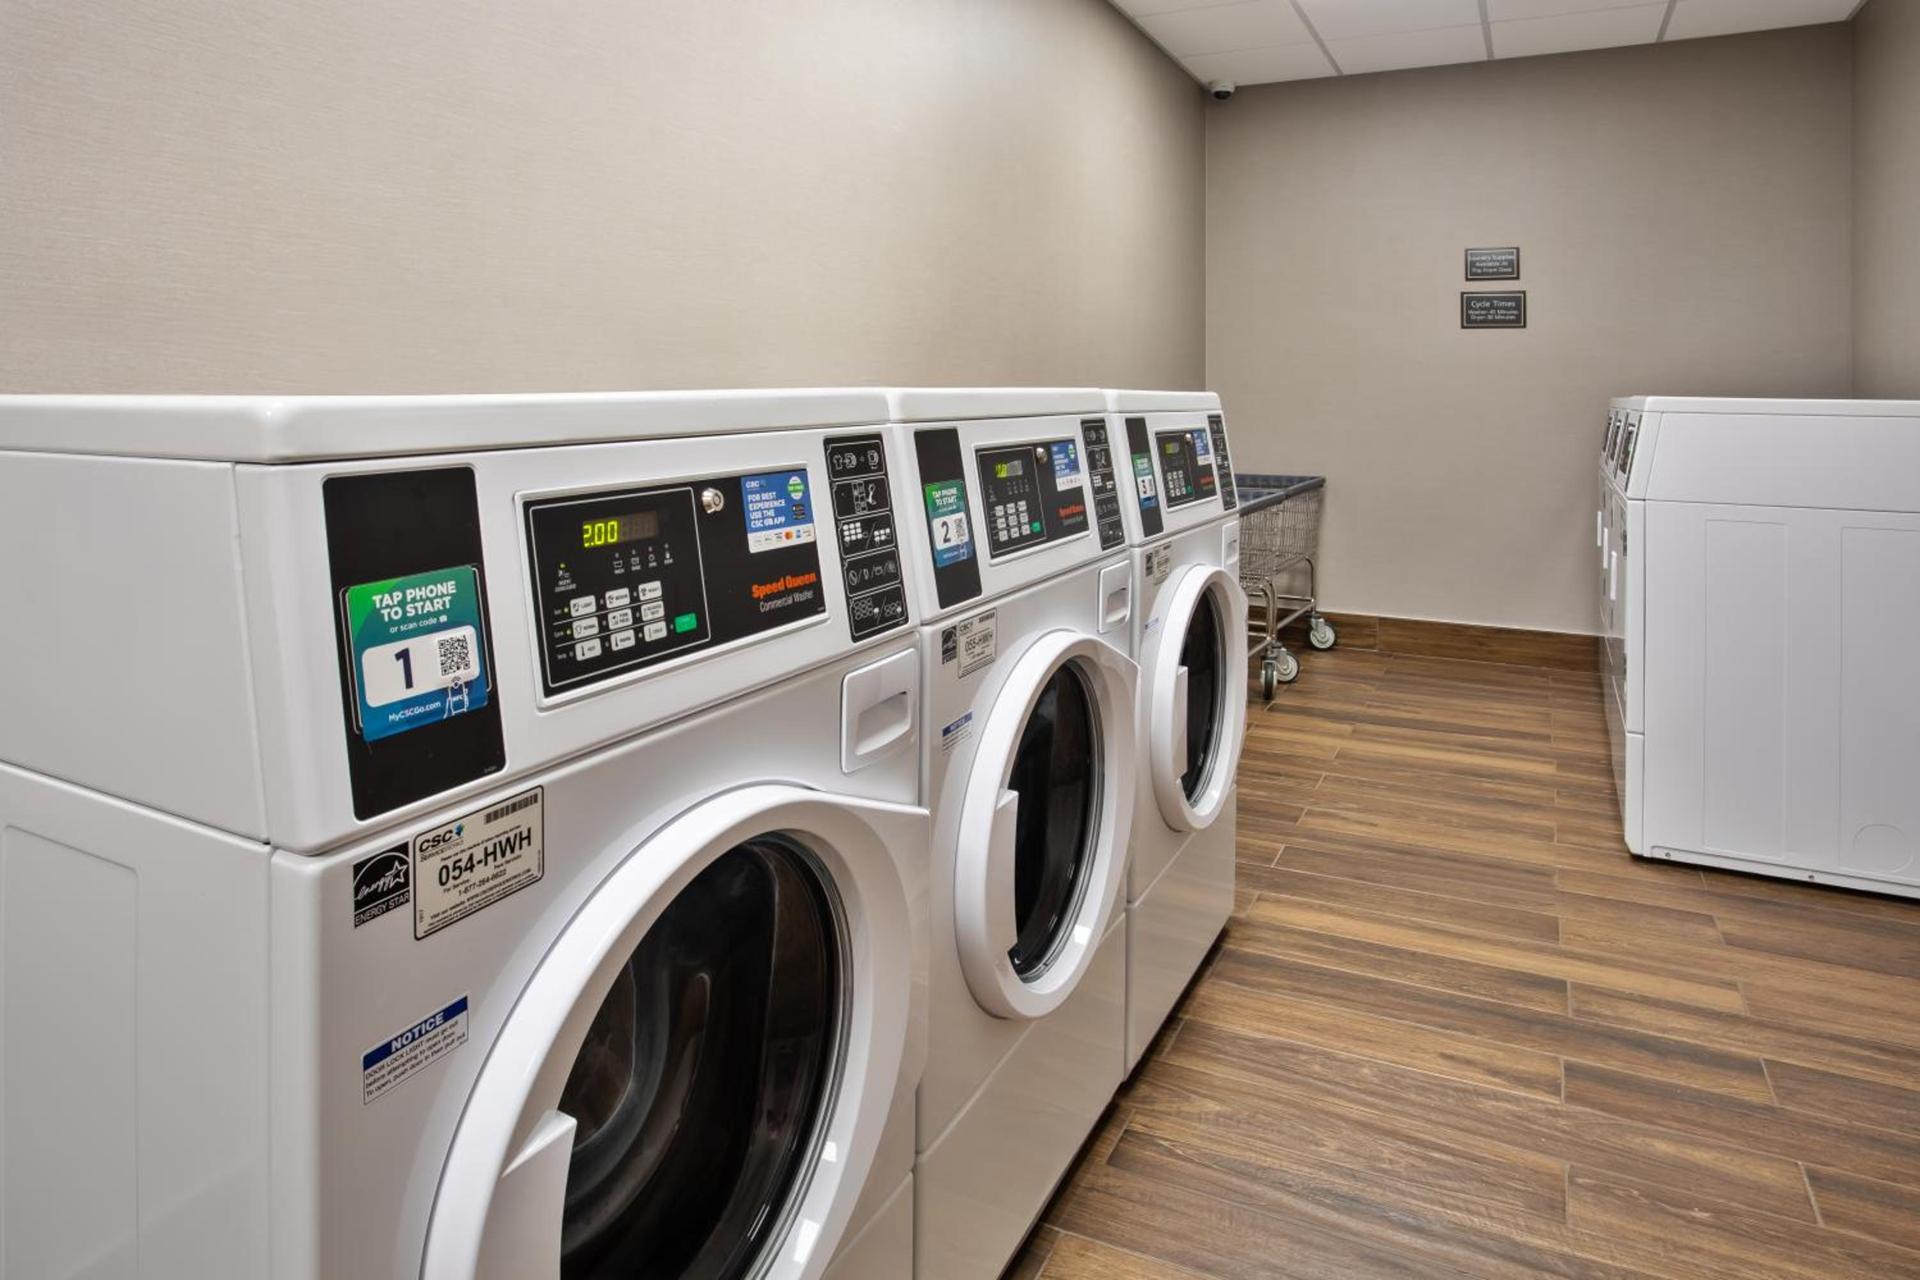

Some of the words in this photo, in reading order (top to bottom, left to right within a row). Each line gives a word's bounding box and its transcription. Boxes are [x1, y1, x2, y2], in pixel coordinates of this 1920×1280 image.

[1471, 300, 1491, 308] Cycle
[1493, 300, 1516, 308] Times
[583, 520, 618, 548] 2.00
[941, 520, 951, 544] 2
[372, 592, 403, 609] TAP
[406, 581, 457, 603] PHONE
[752, 577, 785, 599] Speed
[786, 572, 817, 590] Queen
[381, 606, 403, 622] TO
[406, 596, 452, 617] START
[760, 594, 793, 613] Commercial
[390, 626, 399, 634] or
[400, 622, 418, 633] scan
[419, 616, 438, 628] code
[394, 647, 414, 690] 1
[388, 701, 442, 722] MyCSCGo.com
[419, 830, 453, 853] CSC
[437, 827, 532, 887] 054-HWH
[355, 902, 388, 926] ENERGY
[388, 892, 409, 909] STAR
[391, 1012, 445, 1053] NOTICE
[386, 1053, 405, 1068] LOCK
[405, 1039, 425, 1057] LIGHT
